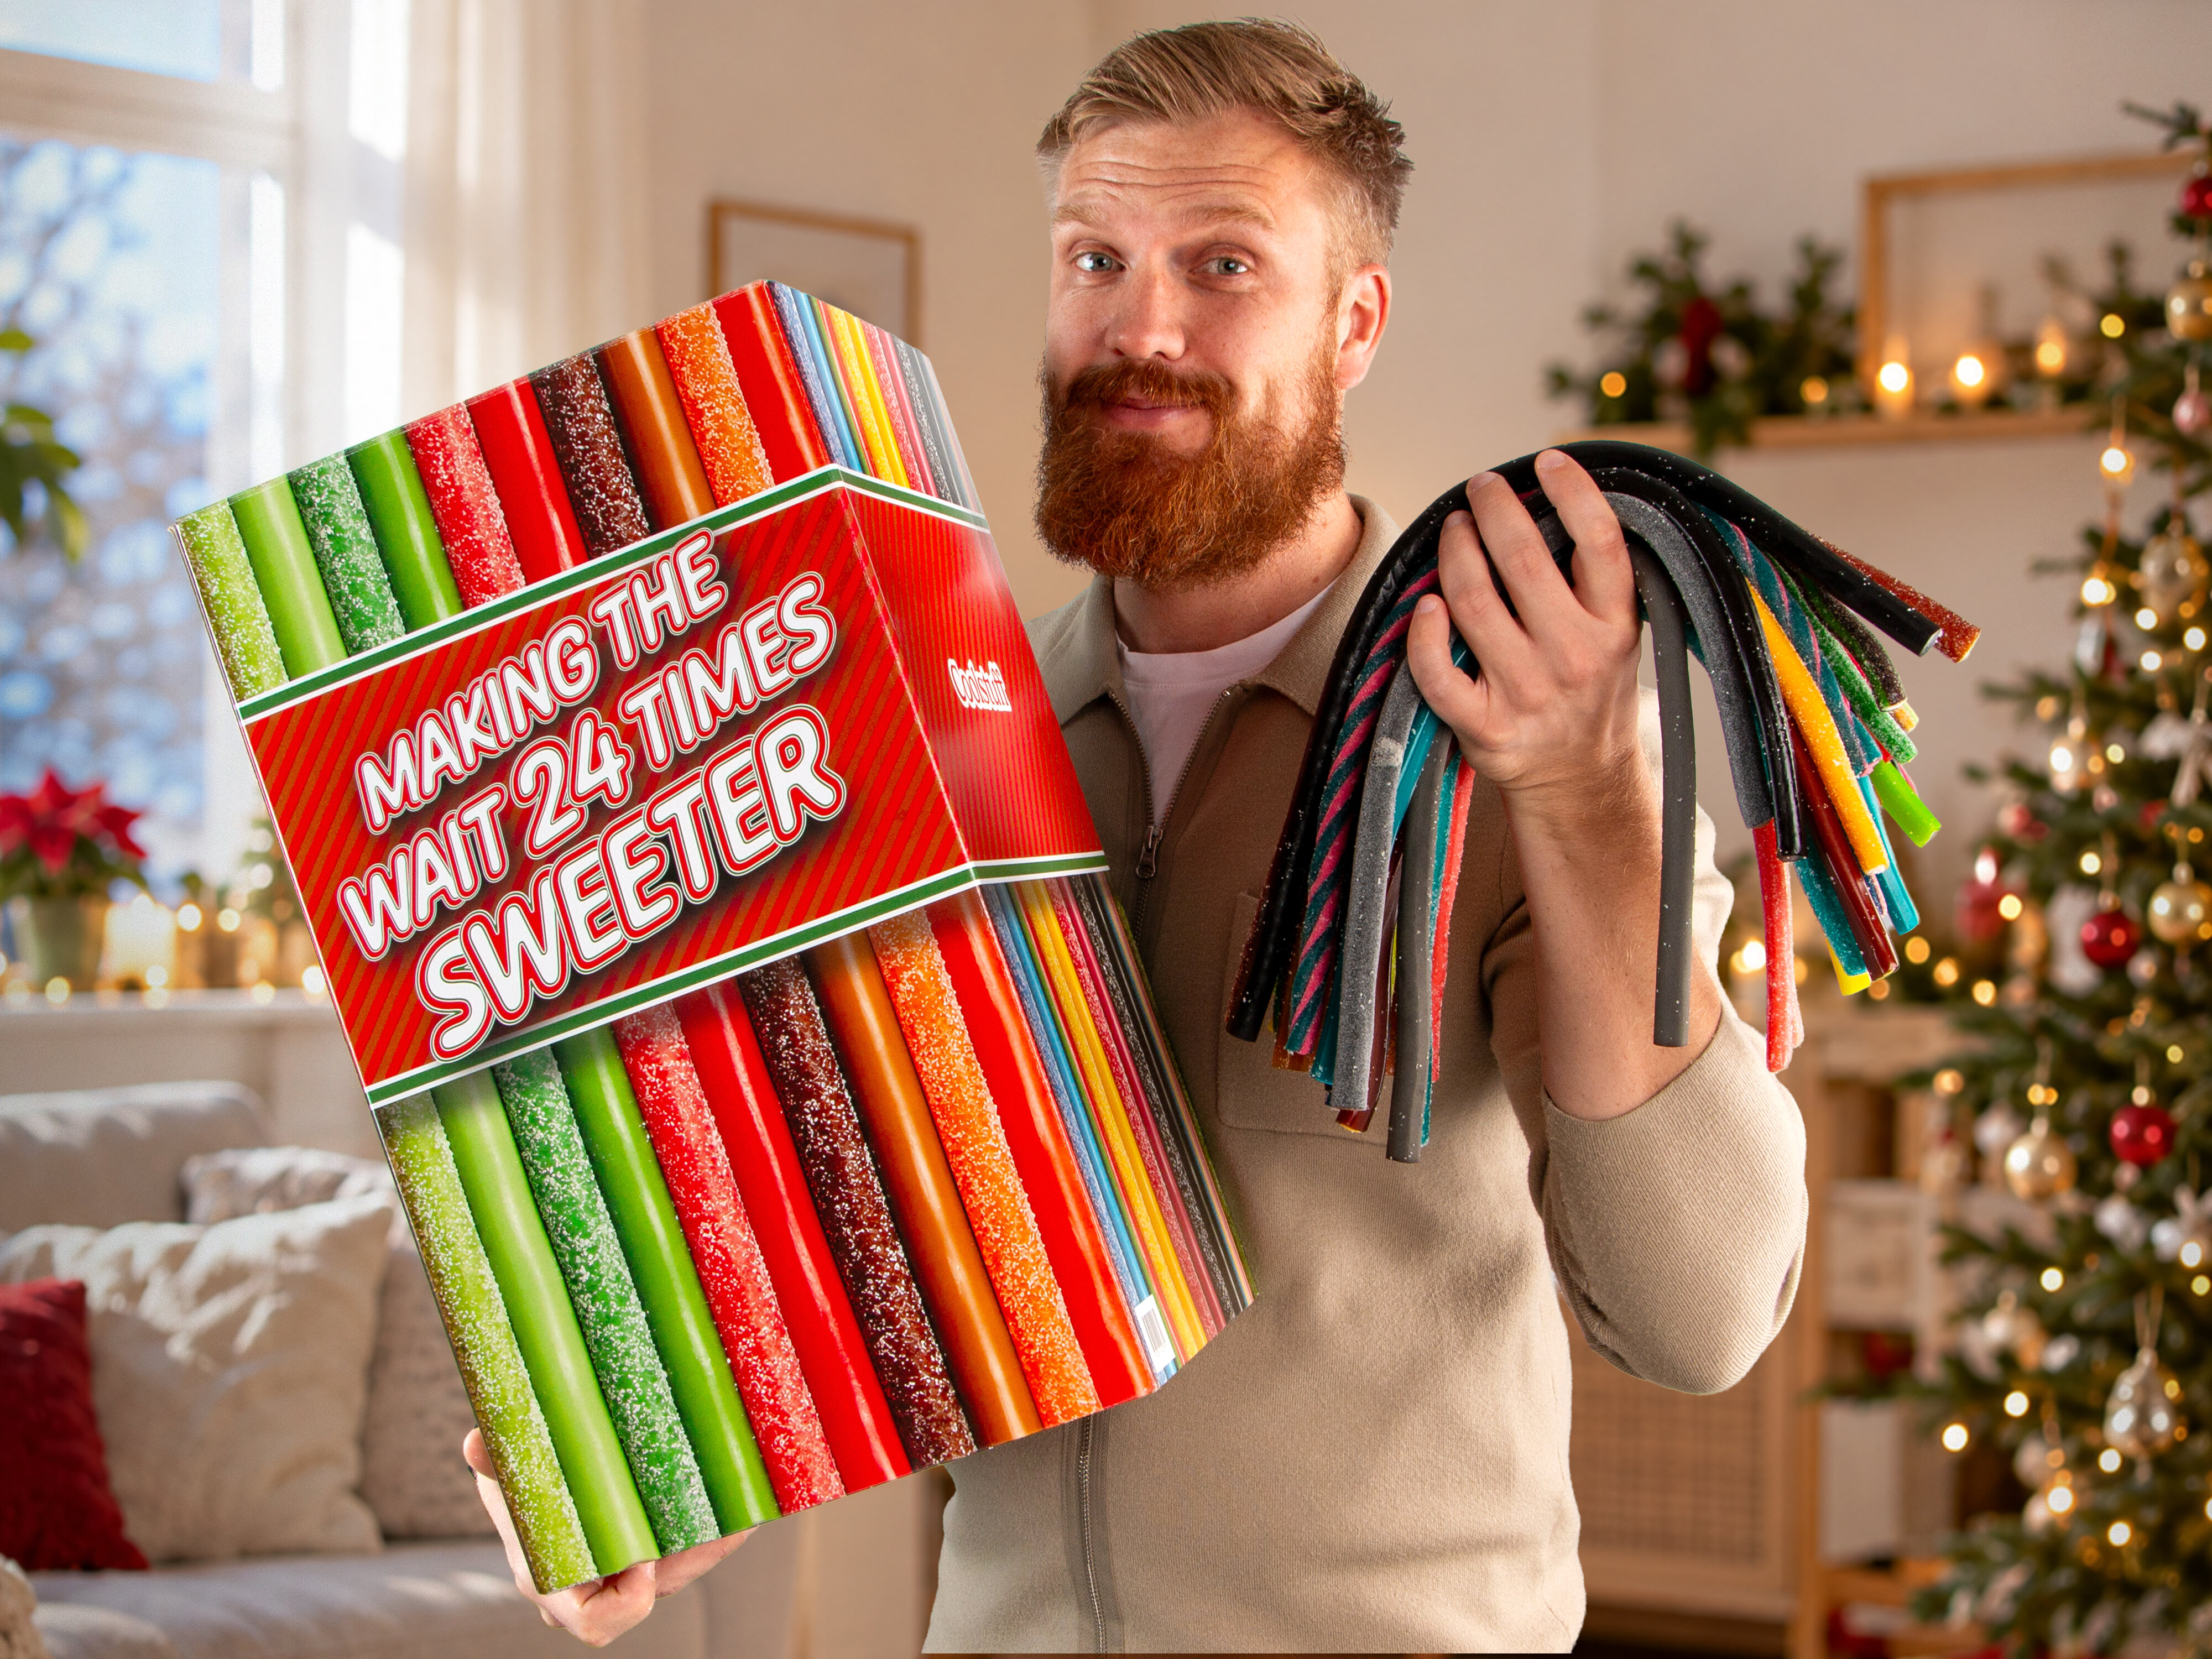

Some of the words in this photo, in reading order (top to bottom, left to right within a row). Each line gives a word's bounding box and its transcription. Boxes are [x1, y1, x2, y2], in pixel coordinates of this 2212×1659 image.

[338, 783, 508, 960] WAIT
[512, 708, 632, 859] 24
[619, 572, 836, 771] TIMES
[357, 617, 599, 834] MAKING
[592, 528, 727, 670] THE
[948, 659, 1011, 711] Coolstuff
[416, 705, 846, 1061] SWEETER
